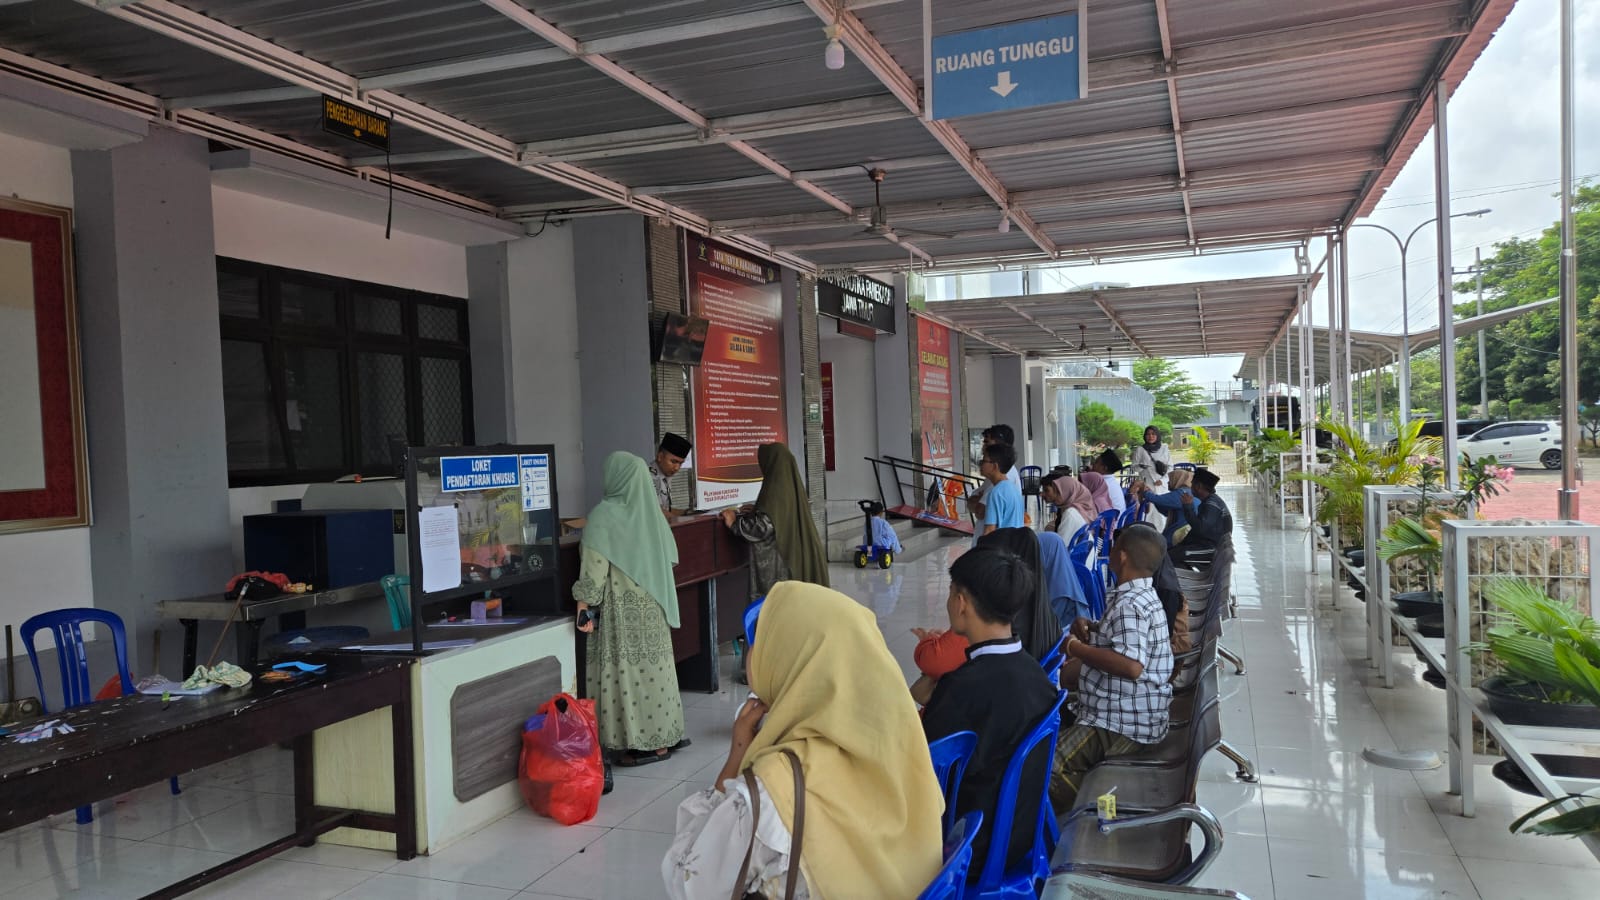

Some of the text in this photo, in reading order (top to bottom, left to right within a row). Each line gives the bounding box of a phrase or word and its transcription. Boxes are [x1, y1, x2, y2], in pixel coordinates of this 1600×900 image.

[935, 36, 1074, 74] RUANG TUNGGU
[841, 292, 858, 316] JAWA
[471, 459, 492, 472] LOKET
[446, 474, 491, 488] PENDAFTARAN
[491, 472, 516, 485] KHUSUS
